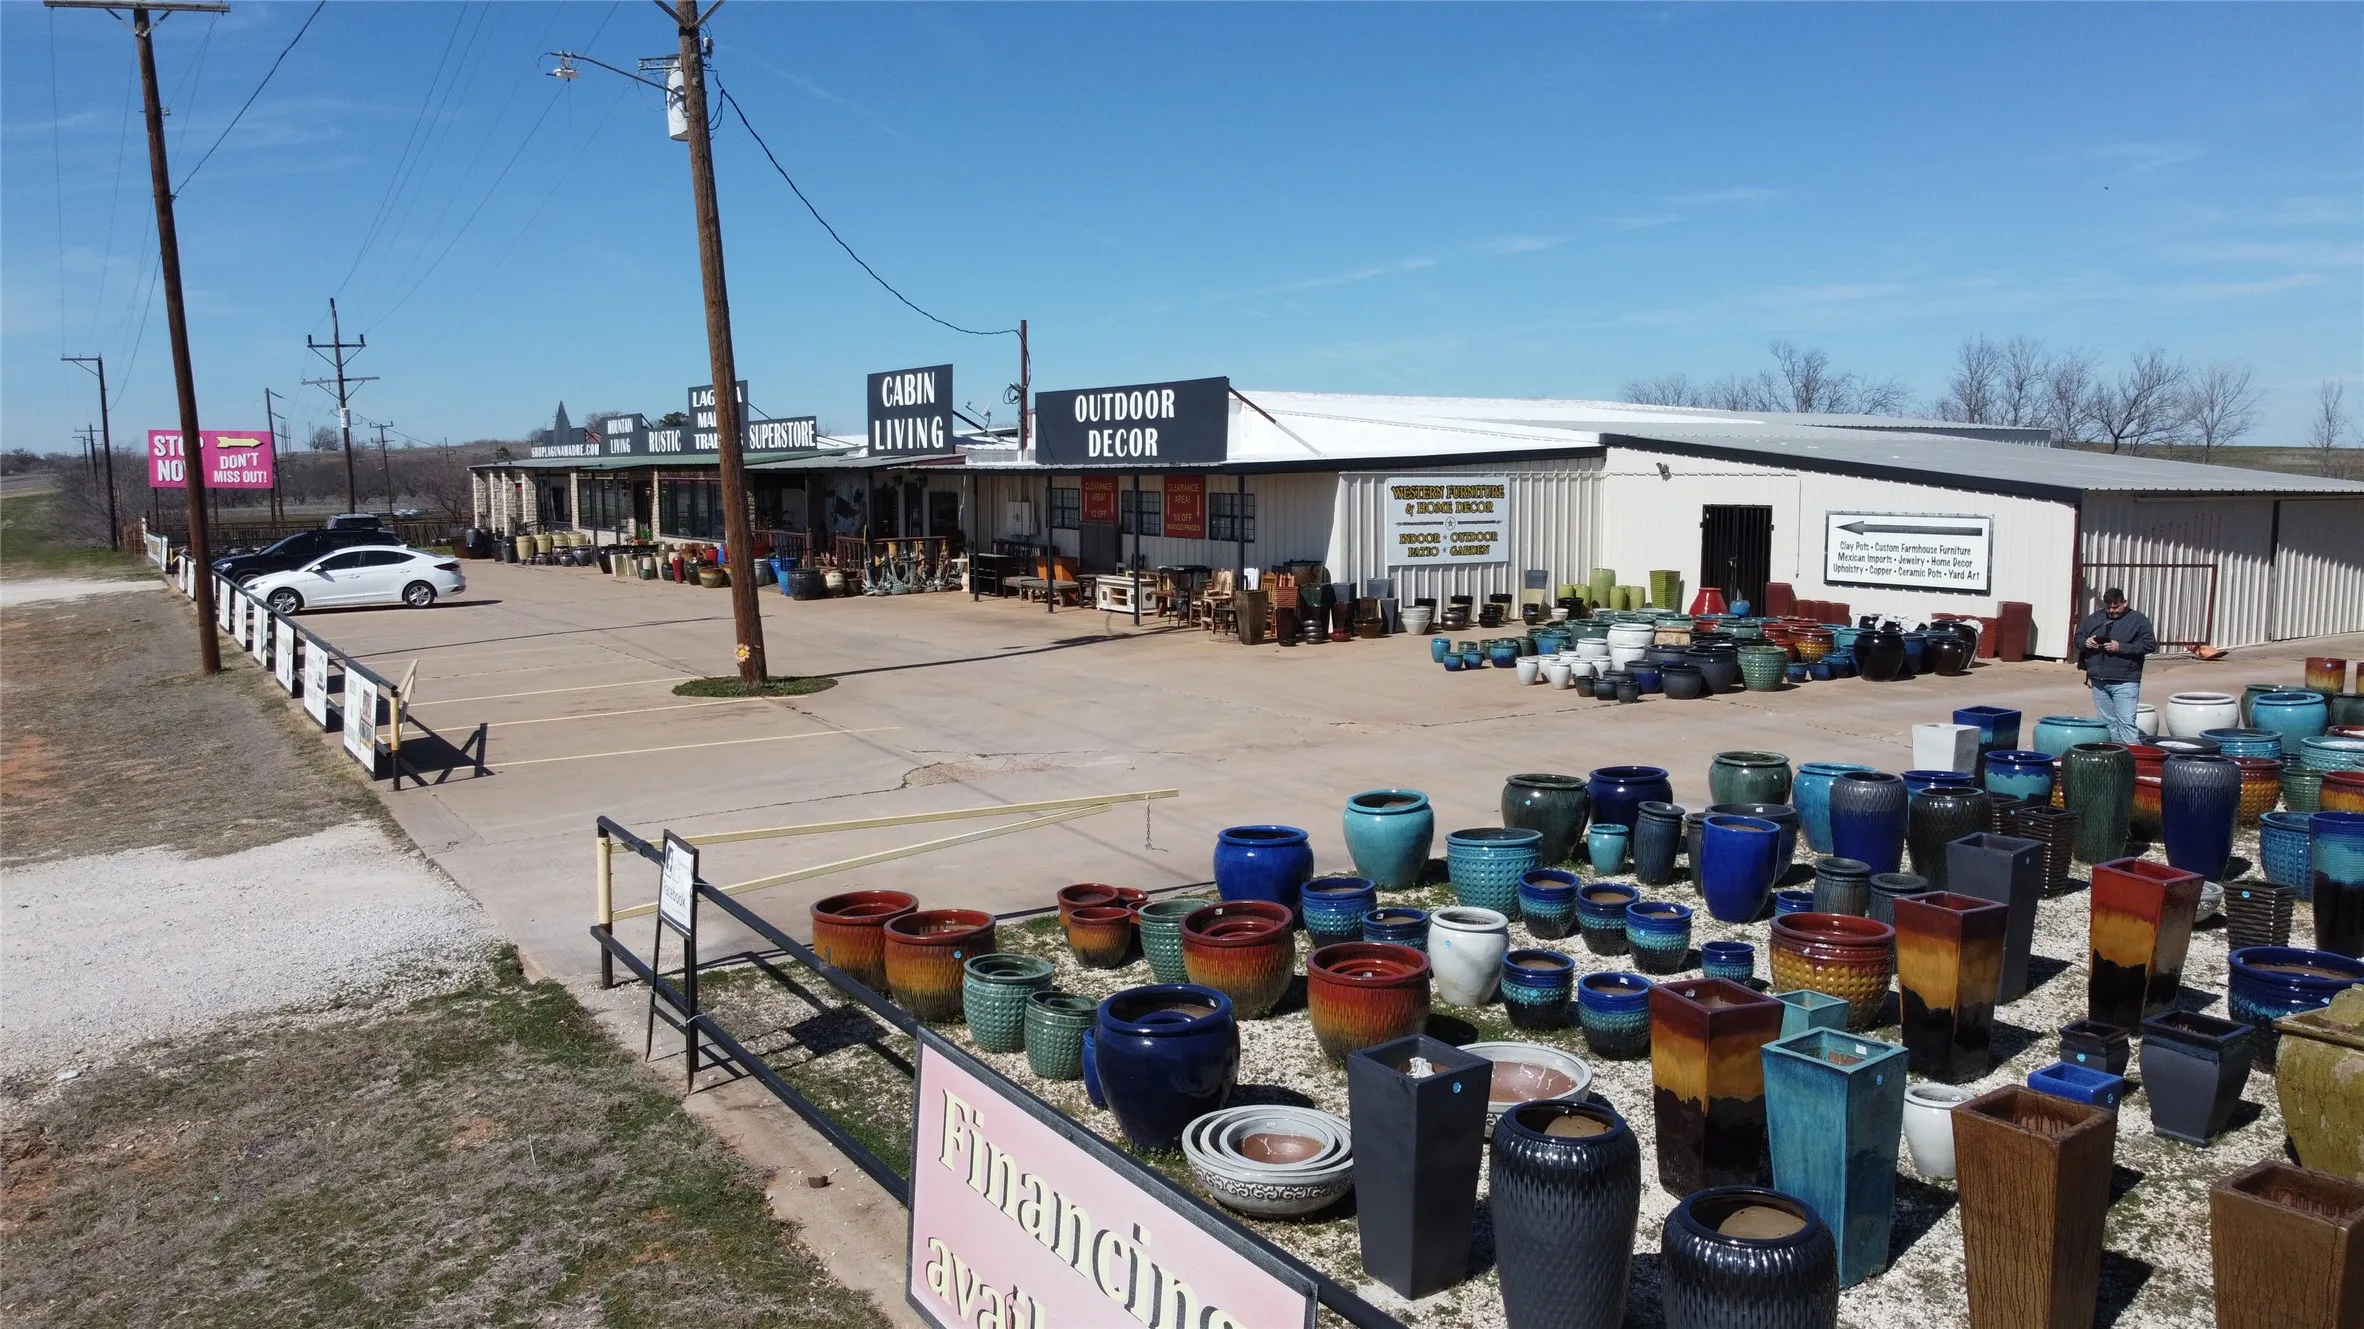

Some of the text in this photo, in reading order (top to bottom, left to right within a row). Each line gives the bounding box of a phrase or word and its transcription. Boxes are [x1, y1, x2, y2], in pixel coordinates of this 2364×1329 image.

[692, 386, 743, 408] LAG
[882, 372, 935, 407] CABIN
[1075, 389, 1175, 423] OUTDOOR
[607, 418, 634, 435] MOUNTAIN
[749, 420, 816, 449] SUPERSTORE
[875, 416, 944, 450] LIVING
[154, 434, 205, 457] ST
[610, 438, 631, 454] LIVING
[648, 430, 681, 453] RUSTIC
[1088, 428, 1158, 457] DECOR
[531, 443, 600, 458] SHOPLAGUNAMADRE.COM
[220, 452, 260, 470] DON'T
[158, 459, 187, 482] NO
[214, 471, 267, 484] MISS OUT!
[1085, 482, 1113, 491] CLEARANCE
[1167, 483, 1200, 493] CLEARANCE
[1391, 484, 1505, 500] WESTERN FURNITURE
[1174, 495, 1191, 504] AREA!
[1405, 501, 1494, 517] & HOME DECOR
[1181, 513, 1193, 522] OFF
[1399, 531, 1498, 544] INDOOR OUTDOOR
[1408, 545, 1490, 557] PATIO GARDEN
[1840, 541, 1971, 555] Clay Pots Custom Farmhouse Furniture
[1838, 552, 1973, 568] Mexican Imports Jewelry Home Decor
[1833, 563, 1980, 580] Upholstry Copper Ceramic Pots Yard Art
[938, 1088, 1250, 1329] Financin
